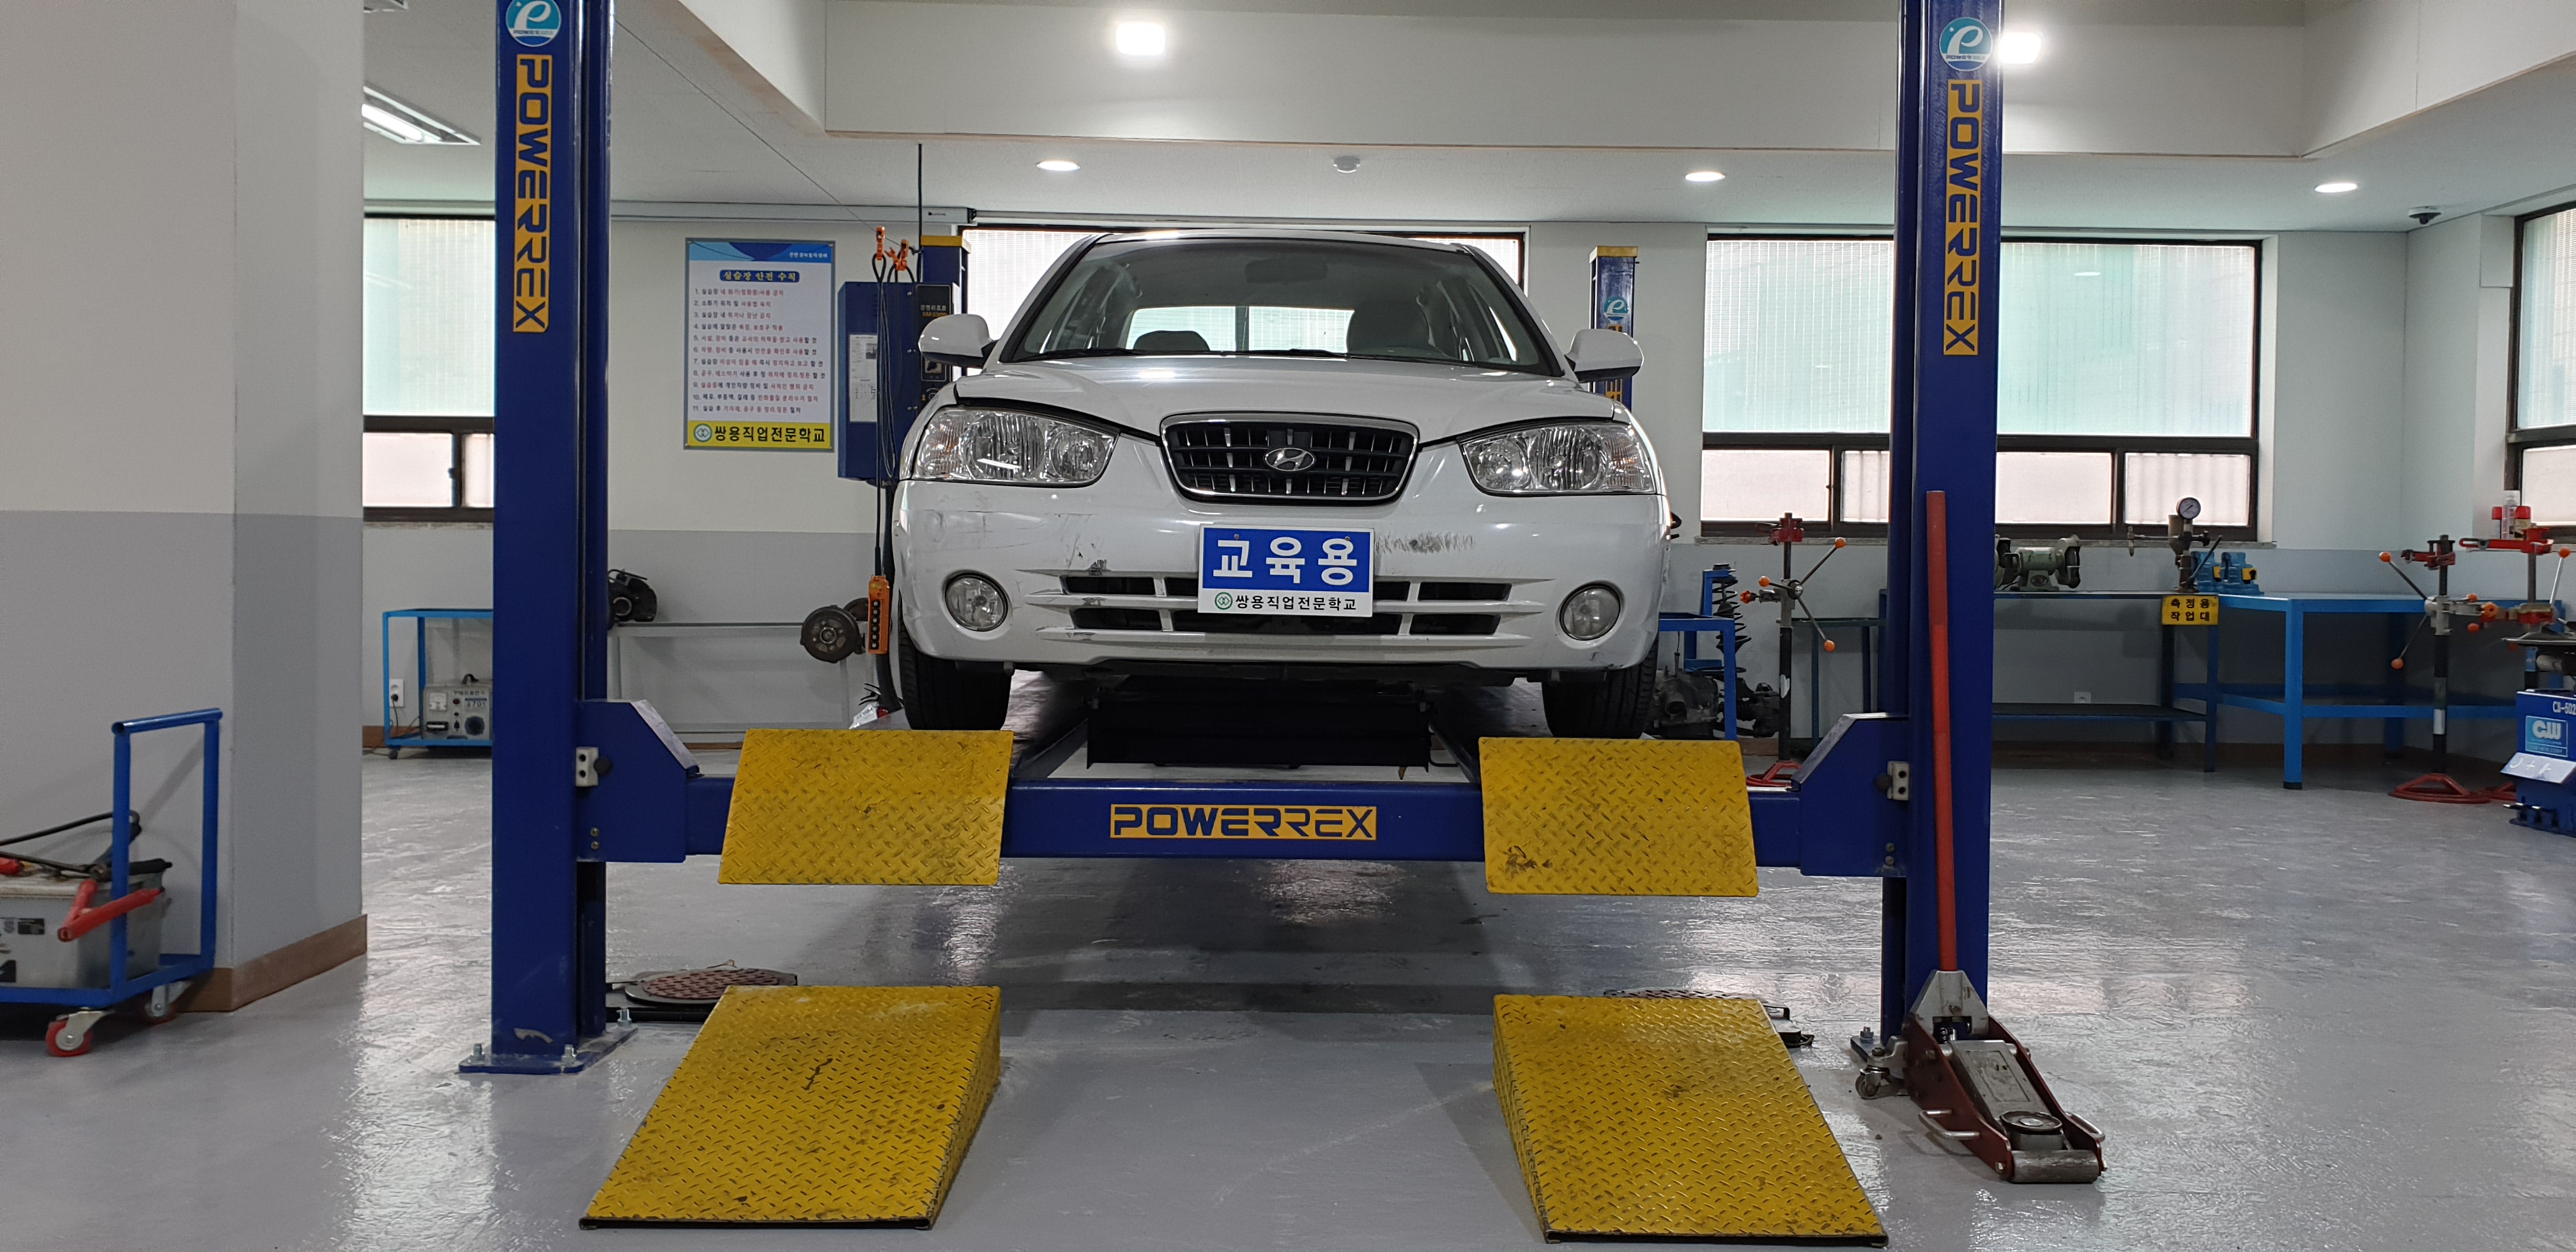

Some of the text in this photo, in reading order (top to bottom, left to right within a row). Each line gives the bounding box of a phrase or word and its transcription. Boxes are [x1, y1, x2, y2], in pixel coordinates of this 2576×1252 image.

[515, 58, 549, 328] POWERREX
[1945, 82, 1981, 352] POWERREX
[723, 270, 753, 281] 실습장
[714, 425, 825, 443] 쌍용직업전문학교
[1213, 537, 1358, 586] 교육용
[1235, 594, 1357, 611] 쌍용직업전문학교
[2171, 598, 2210, 609] 측정용
[2171, 611, 2210, 622] 작업대
[2532, 719, 2561, 740] CW
[1114, 806, 1374, 838] POWERREX
